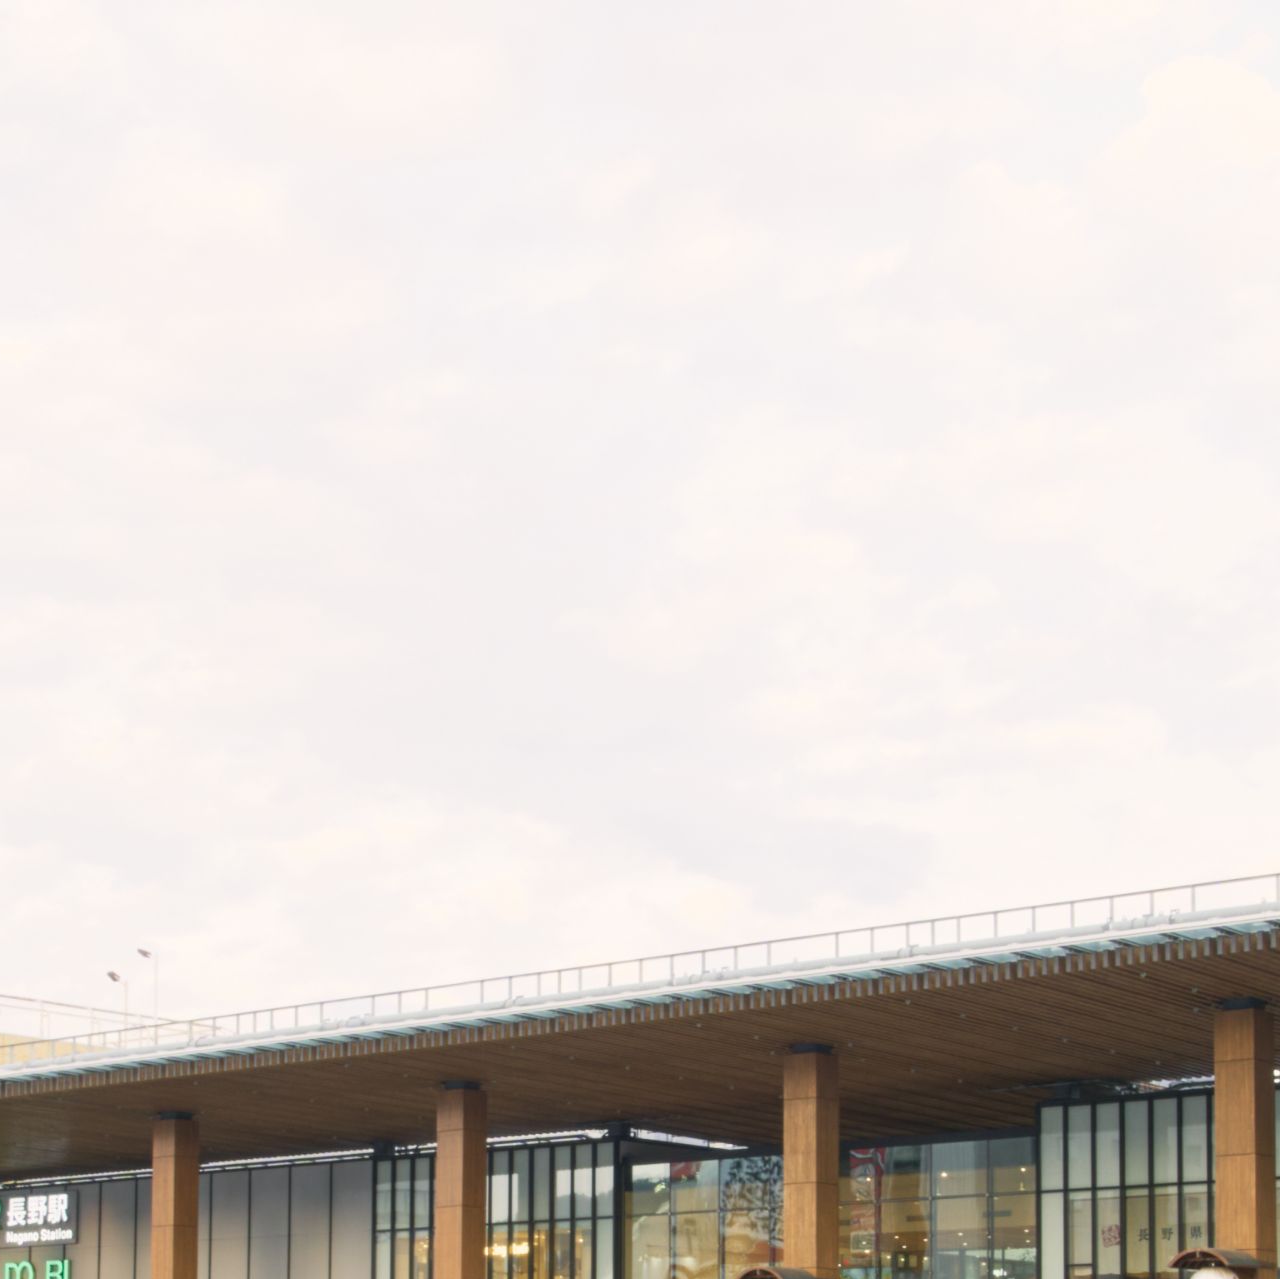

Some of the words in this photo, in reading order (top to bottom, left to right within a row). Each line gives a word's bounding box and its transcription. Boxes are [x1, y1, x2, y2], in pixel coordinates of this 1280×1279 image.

[6, 1193, 69, 1227] 長野駅
[6, 1230, 39, 1245] Nagano
[40, 1228, 73, 1241] Station
